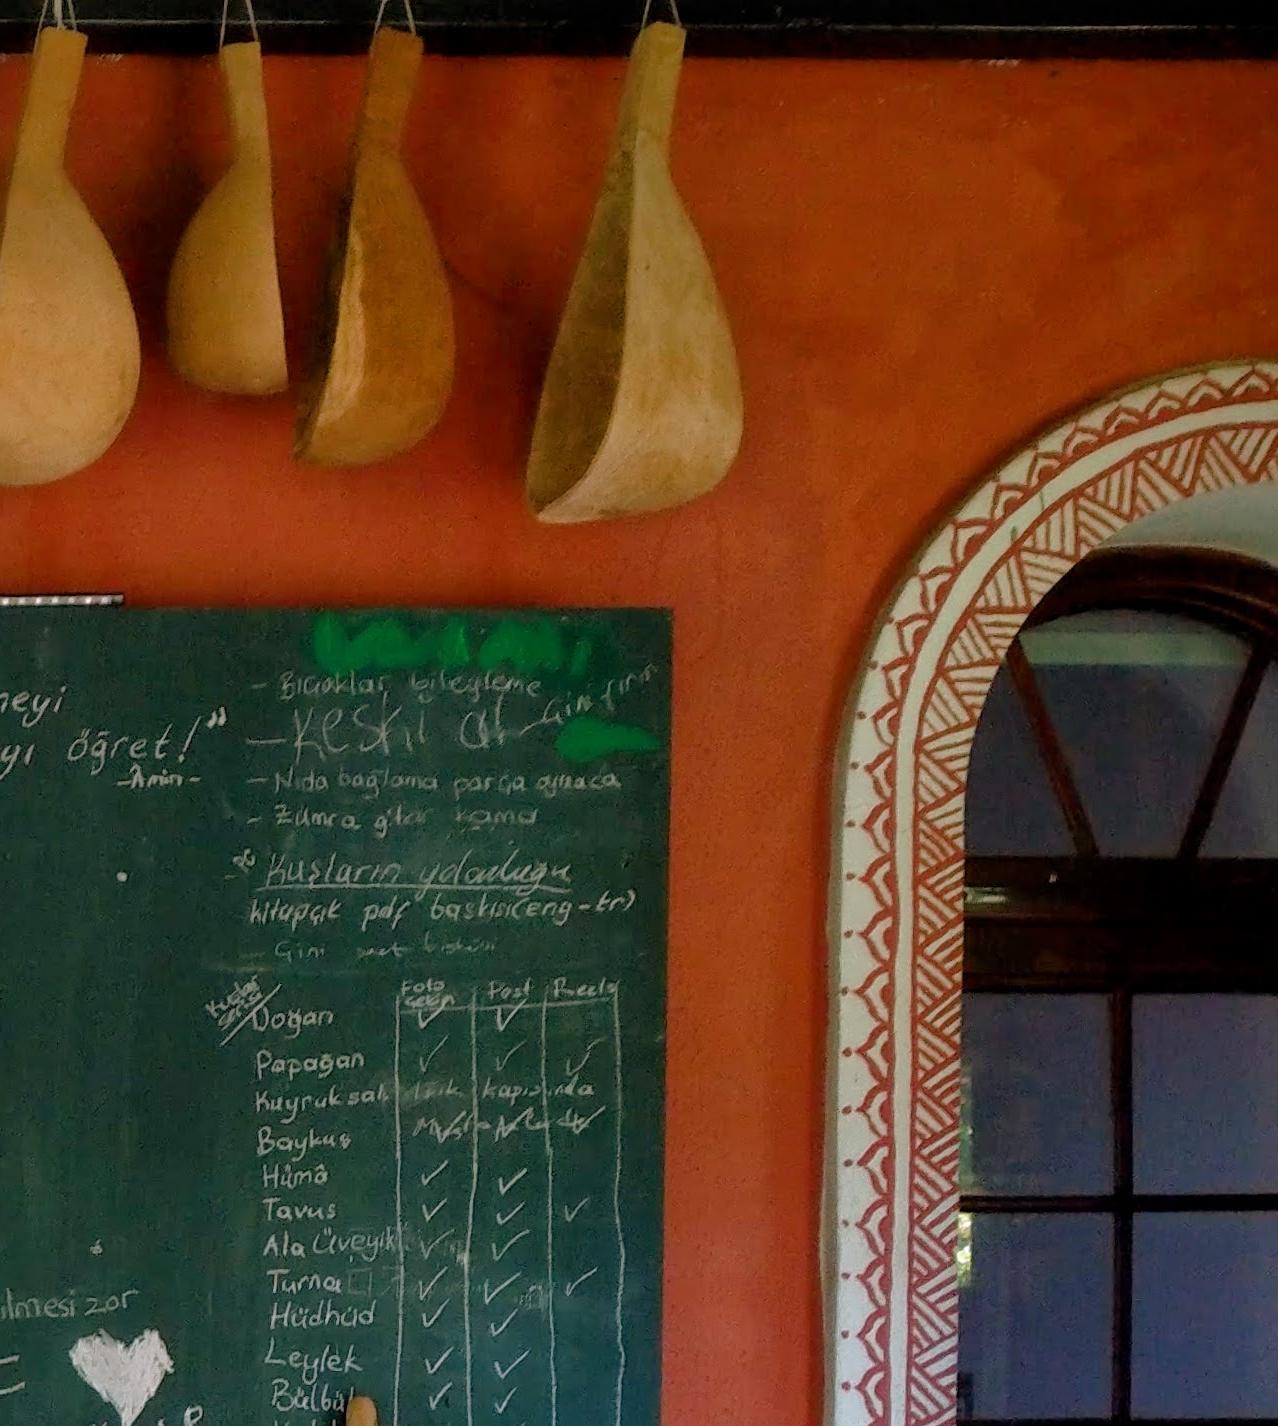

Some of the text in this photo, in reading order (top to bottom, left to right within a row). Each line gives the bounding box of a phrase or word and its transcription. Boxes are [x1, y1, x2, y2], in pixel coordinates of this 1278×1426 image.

[251, 1006, 334, 1039] Doğan
[255, 1048, 366, 1081] Papağan
[262, 1197, 337, 1222] Tavus
[262, 1230, 307, 1258] Ala
[266, 1268, 342, 1295] Turna
[83, 1287, 140, 1316] zor
[264, 1337, 364, 1386] Leylek
